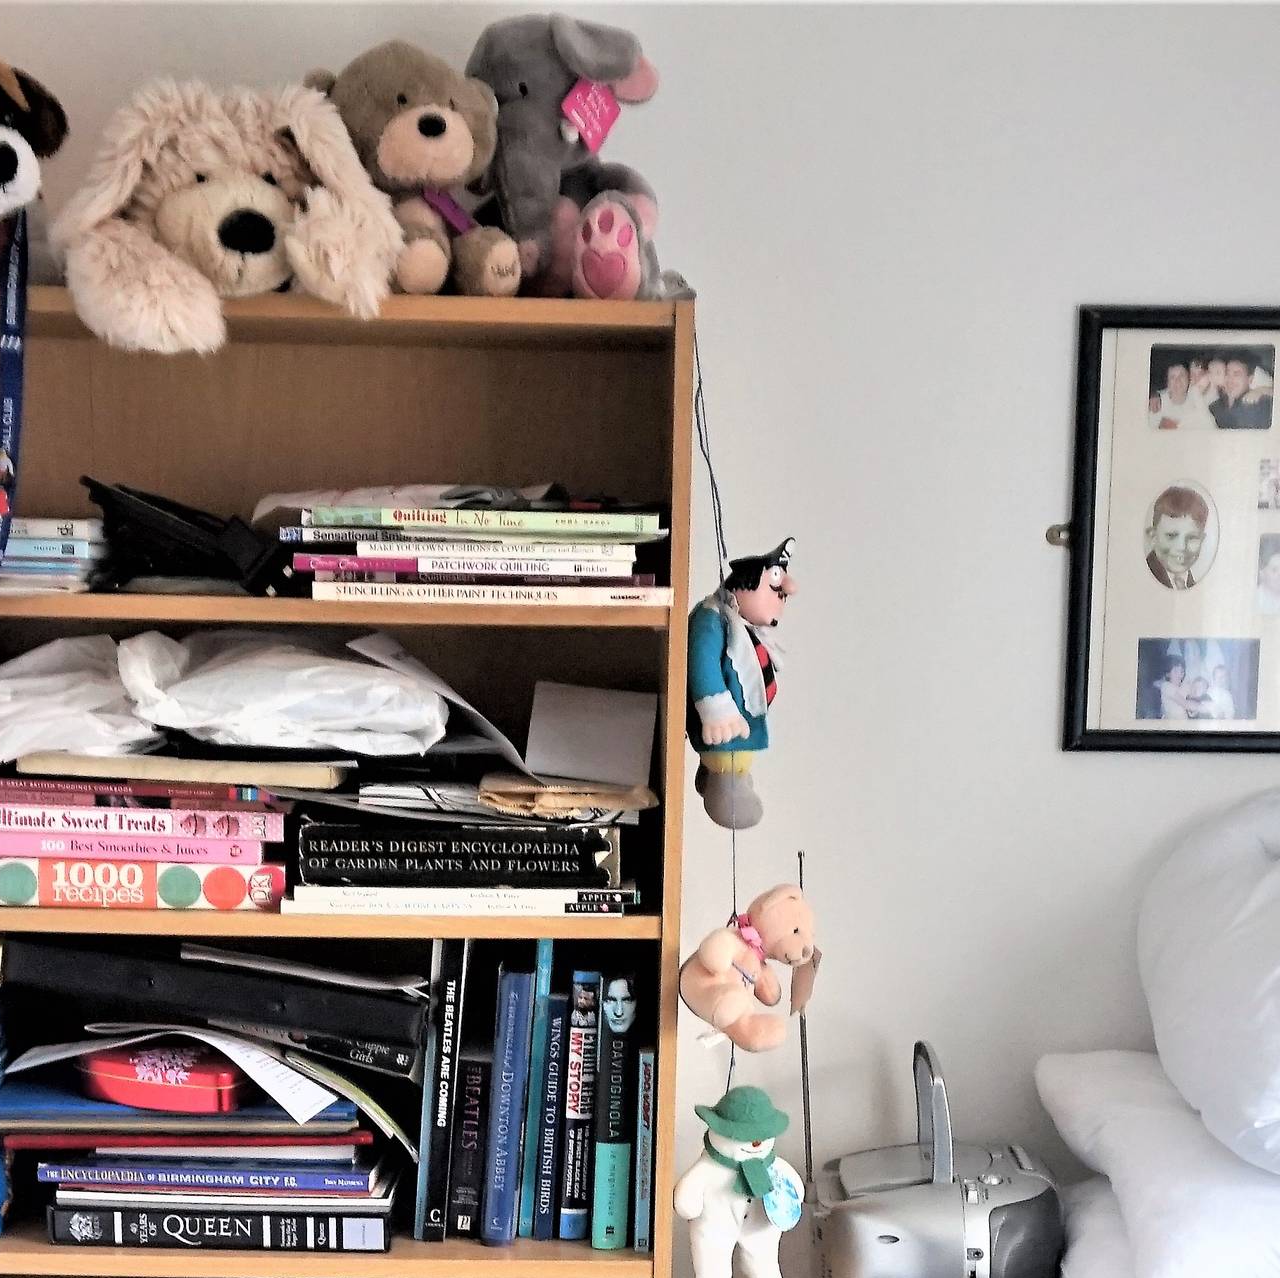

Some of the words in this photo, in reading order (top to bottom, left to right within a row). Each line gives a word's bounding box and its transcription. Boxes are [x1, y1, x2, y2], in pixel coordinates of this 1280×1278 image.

[393, 509, 447, 525] Quilting
[473, 511, 490, 527] No
[497, 513, 524, 527] Time
[312, 530, 379, 542] Sensational
[369, 543, 393, 552] MAKE
[396, 543, 421, 552] YOUR
[422, 544, 444, 553] OWN
[505, 544, 536, 553] COVERS
[431, 560, 497, 571] PATCHWORK
[500, 562, 551, 573] QUILTING
[336, 585, 405, 596] STENCILLING
[406, 586, 414, 596] &
[417, 587, 454, 598] OTHER
[456, 588, 487, 598] PAINT
[491, 588, 558, 601] TECHNIQUES
[61, 811, 108, 830] Sweet
[115, 814, 167, 832] Treats
[41, 839, 66, 851] 100
[70, 840, 94, 852] Best
[98, 841, 158, 854] Smoothies
[161, 844, 172, 854] &
[176, 843, 209, 856] Juices
[308, 840, 384, 853] READER'S
[389, 840, 447, 854] DIGEST
[451, 841, 580, 856] ENCYCLOPAEDIA
[52, 861, 144, 889] 1000
[308, 857, 329, 869] OF
[335, 858, 398, 870] GARDEN
[405, 858, 463, 871] PLANTS
[469, 859, 501, 871] AND
[508, 860, 580, 872] FLOWERS
[52, 885, 144, 908] recipes
[569, 904, 598, 912] APPLE
[581, 893, 611, 902] APPLE
[444, 979, 457, 1002] THE
[441, 1003, 456, 1054] BEATLES
[549, 1017, 562, 1058] WINGS
[570, 1031, 583, 1056] MY
[349, 1048, 375, 1064] Girls
[439, 1055, 451, 1080] ARE
[545, 1062, 560, 1102] GUIDE
[567, 1058, 582, 1114] STORY
[436, 1081, 450, 1128] COMING
[462, 1072, 483, 1151] BEATLES
[498, 1071, 515, 1141] DOWNTON
[544, 1106, 556, 1124] TO
[541, 1128, 556, 1175] BRITISH
[60, 1168, 145, 1182] ENCYCLOPAEDIA
[157, 1173, 245, 1185] BIRMINGHAM
[249, 1175, 280, 1187] CITY
[494, 1143, 510, 1192] ABBEY
[539, 1179, 552, 1215] BIRDS
[139, 1213, 148, 1244] YEARS
[149, 1221, 157, 1236] OF
[163, 1213, 253, 1246] QUEEN
